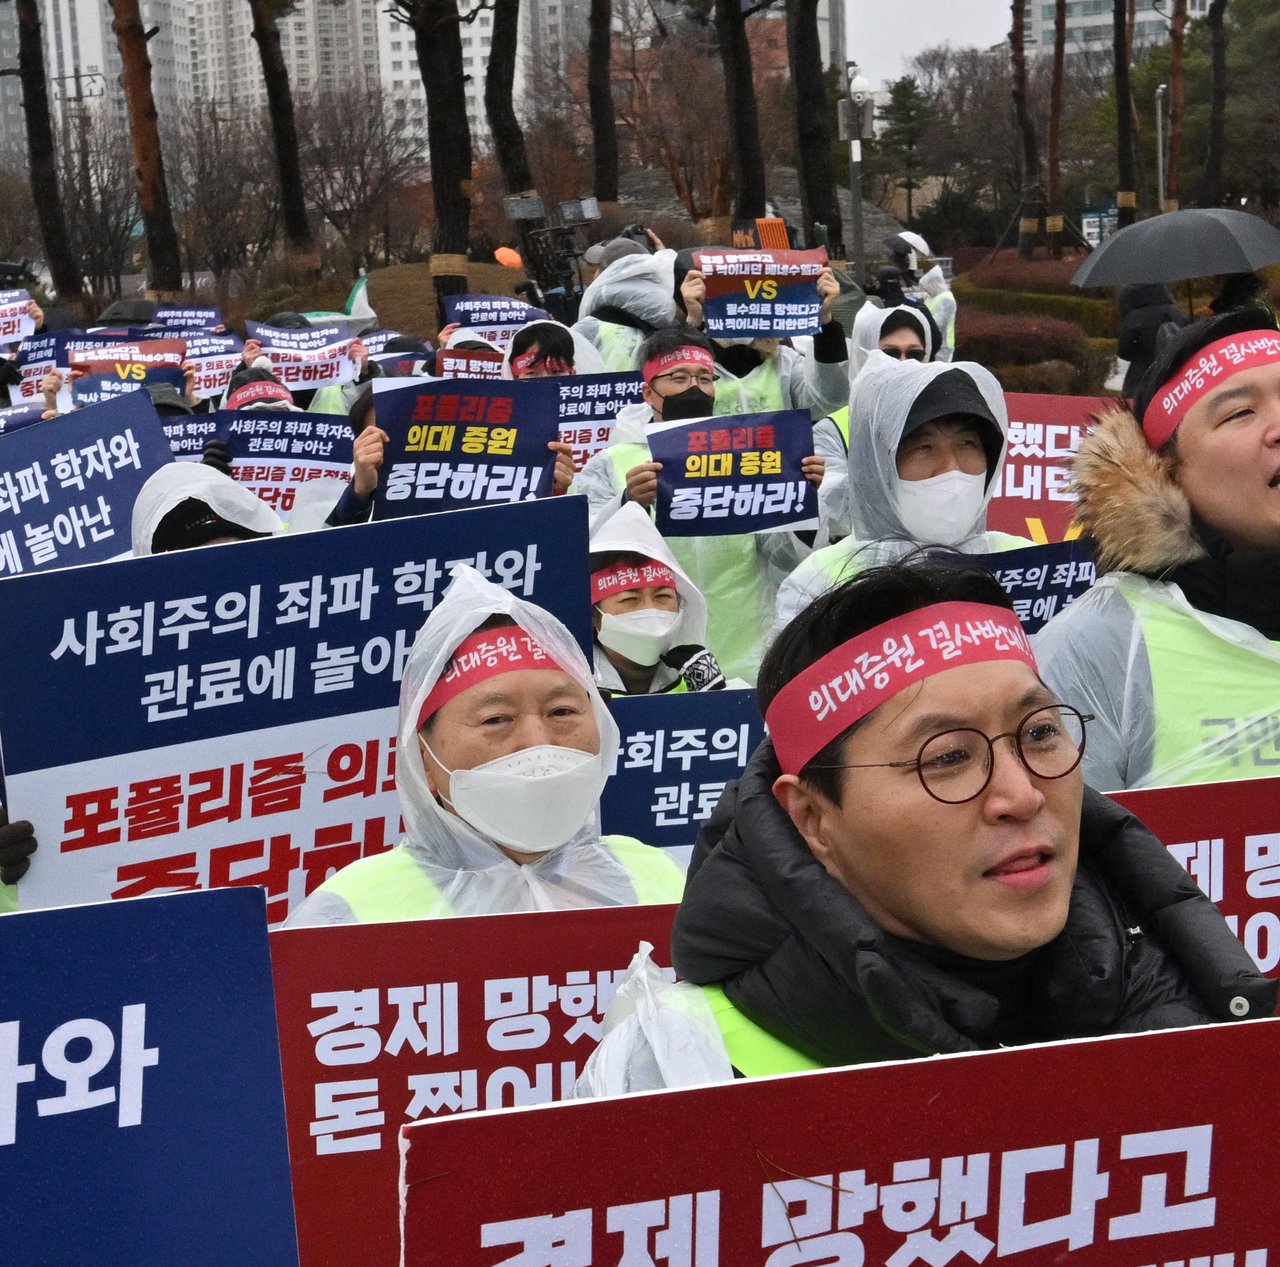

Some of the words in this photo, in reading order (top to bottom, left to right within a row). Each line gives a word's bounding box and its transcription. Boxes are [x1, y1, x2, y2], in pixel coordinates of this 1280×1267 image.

[744, 280, 778, 299] VS
[725, 319, 770, 330] 찍어내는
[773, 317, 819, 330] 대한민국
[726, 304, 772, 316] 필수의료
[774, 304, 821, 316] 망했다고
[115, 364, 146, 380] VS
[443, 358, 467, 371] 경제
[586, 383, 612, 398] 좌파
[1162, 354, 1223, 414] 의대증원
[229, 420, 283, 436] 사회주의
[284, 420, 313, 437] 좌파
[404, 425, 457, 453] 의대
[461, 426, 518, 457] 증원
[50, 429, 141, 492] 학자와
[248, 438, 289, 453] 관료에
[290, 440, 333, 456] 놀아난
[385, 462, 544, 501] 중단하라!
[684, 453, 733, 479] 의대
[739, 451, 783, 476] 증원
[669, 480, 806, 522] 중단하라!
[25, 496, 116, 566] 놀아난
[597, 567, 640, 591] 의대증원
[49, 585, 263, 668] 사회주의
[276, 567, 381, 630] 좌파
[139, 645, 296, 724] 관료에
[809, 634, 925, 721] 의대증원
[59, 751, 309, 855] 포퓰리즘
[306, 981, 459, 1068] 경제
[482, 969, 621, 1054] 망했
[308, 1077, 386, 1157] 돈
